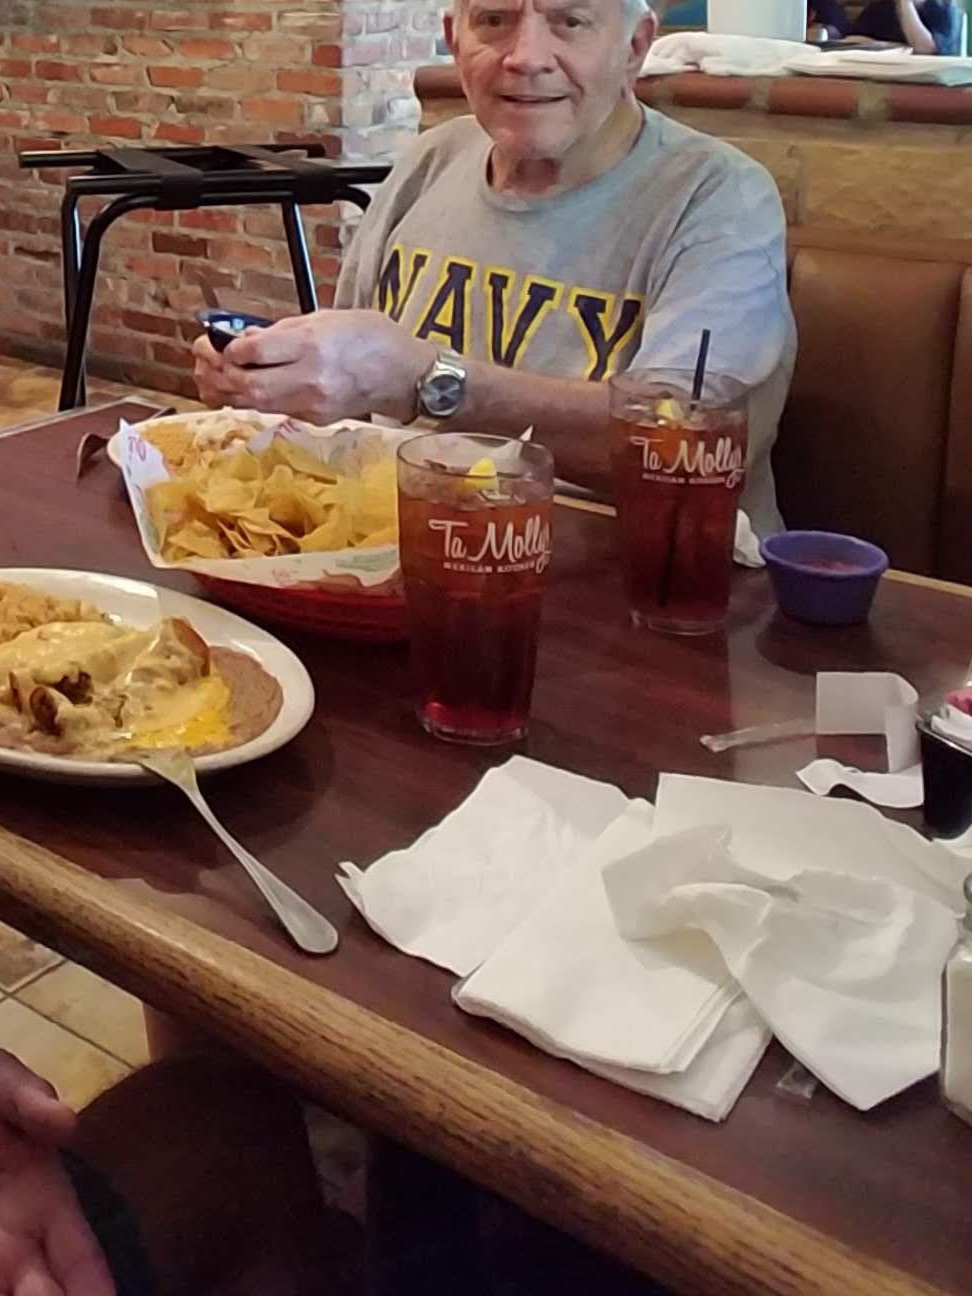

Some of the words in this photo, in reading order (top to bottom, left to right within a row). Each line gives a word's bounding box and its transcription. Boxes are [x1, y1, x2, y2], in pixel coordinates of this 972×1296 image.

[378, 244, 646, 383] NAVY
[629, 435, 664, 471] Ta
[428, 518, 468, 559] Ta
